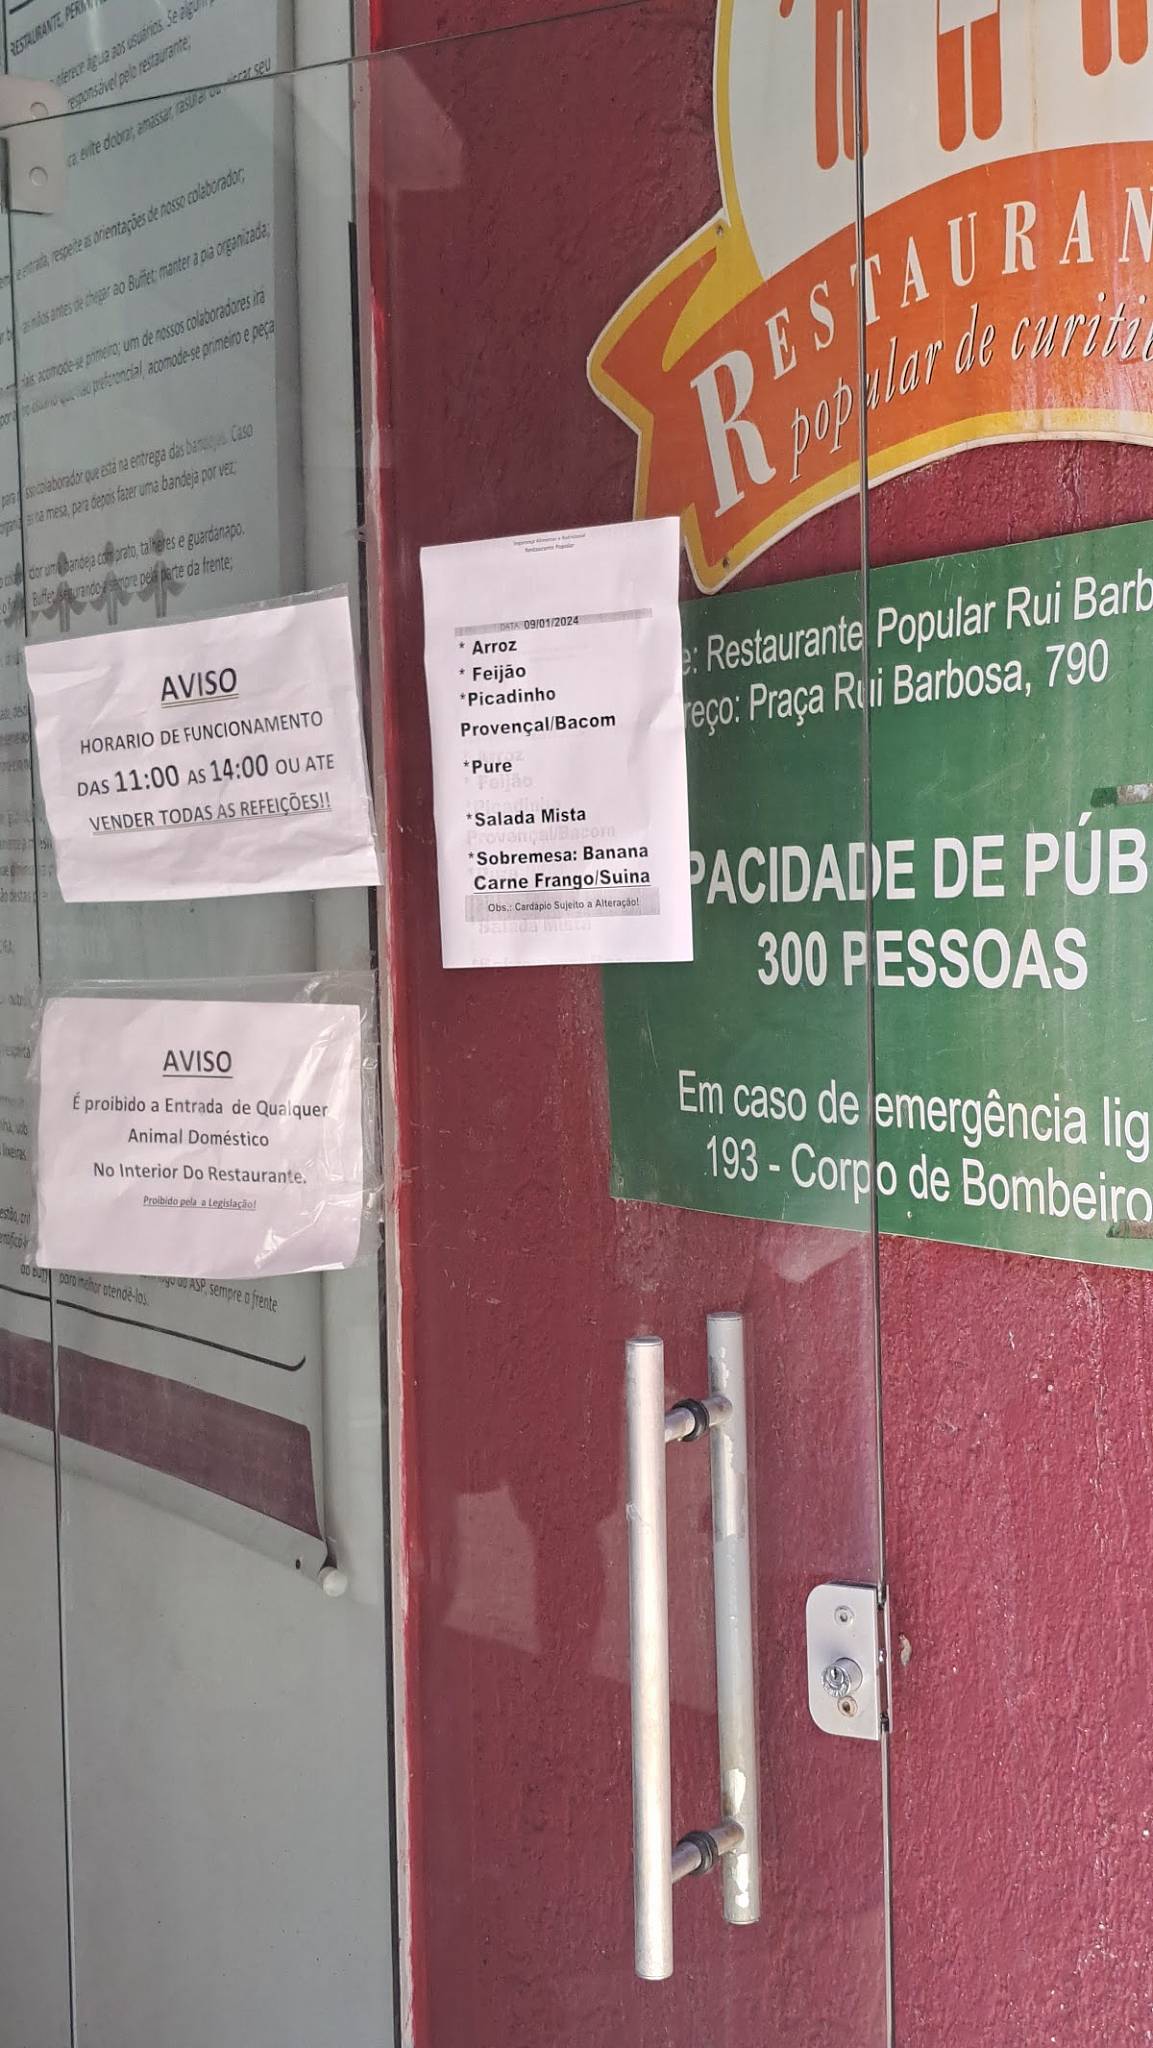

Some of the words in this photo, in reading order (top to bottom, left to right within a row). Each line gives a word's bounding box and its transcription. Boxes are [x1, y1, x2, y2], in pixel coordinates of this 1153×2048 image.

[253, 57, 272, 77] seu
[160, 193, 186, 218] nosso
[112, 280, 126, 297] ao
[158, 254, 192, 280] manter
[123, 336, 139, 352] um
[142, 329, 155, 347] de
[155, 320, 185, 344] nossos
[185, 296, 251, 333] colaboradores
[147, 344, 201, 376] acomode-se
[242, 328, 251, 344] e
[251, 317, 276, 346] peça
[690, 186, 1153, 518] RESTAURAN
[788, 338, 945, 483] popular
[954, 302, 996, 376] de
[130, 448, 166, 468] entrega
[160, 468, 200, 492] bandeja
[201, 465, 218, 487] por
[187, 560, 201, 577] da
[524, 615, 579, 630] 09/01/2024
[682, 644, 699, 676] e:
[706, 619, 864, 673] Restaurante
[876, 597, 996, 652] Popular
[1006, 580, 1062, 631] Rui
[1073, 567, 1153, 622] Barb
[471, 640, 518, 655] Arroz
[160, 667, 238, 703] AVISO
[472, 663, 527, 683] Feijão
[683, 692, 741, 736] reço:
[749, 681, 824, 726] Praça
[834, 669, 884, 711] Rui
[892, 655, 1032, 706] Barbosa,
[1045, 638, 1109, 688] 790
[80, 731, 155, 755] HORARIO
[159, 727, 181, 746] DE
[183, 710, 323, 743] FUNCIONAMENTO
[460, 713, 617, 737] Provençal/Bacom
[77, 779, 110, 797] DAS
[114, 765, 180, 793] 11:00
[187, 769, 207, 785] AS
[209, 754, 269, 782] 14:00
[275, 757, 301, 775] OU
[305, 754, 336, 771] ATE
[89, 810, 155, 832] VENDER
[159, 805, 214, 826] TODAS
[217, 803, 236, 820] AS
[240, 792, 331, 817] REFEIÇÕES!!
[541, 807, 587, 824] Mista
[582, 845, 649, 861] Banana
[690, 838, 915, 904] PACIDADE
[934, 834, 1005, 898] DE
[1025, 811, 1148, 896] PÚB
[473, 873, 529, 891] Carne
[534, 868, 651, 890] Frango/Suina
[553, 899, 585, 912] Sujeito
[595, 897, 640, 910] Alteração!
[757, 930, 827, 987] 300
[843, 927, 1089, 991] PESSOAS
[162, 1050, 233, 1073] AVISO
[72, 1092, 81, 1110] É
[85, 1095, 146, 1116] proibido
[151, 1103, 160, 1113] a
[165, 1097, 223, 1115] Entrada
[231, 1098, 251, 1116] de
[256, 1099, 328, 1121] Qualquer
[678, 1069, 724, 1115] Em
[733, 1084, 806, 1123] caso
[818, 1078, 860, 1125] de
[874, 1088, 1087, 1149] emergência
[1103, 1095, 1150, 1163] lig
[128, 1127, 183, 1145] Animal
[188, 1128, 270, 1147] Doméstico
[93, 1162, 115, 1178] No
[120, 1163, 178, 1180] Interior
[183, 1165, 204, 1180] Do
[208, 1166, 307, 1185] Restaurante.
[705, 1134, 758, 1183] 193
[791, 1142, 898, 1205] Corpo
[908, 1153, 950, 1202] de
[962, 1157, 1153, 1224] Bombeiro
[143, 1195, 178, 1206] Proibido
[180, 1197, 197, 1207] pela
[208, 1198, 256, 1210] Legislação!
[208, 1283, 243, 1306] sempre
[250, 1288, 279, 1313] frente
